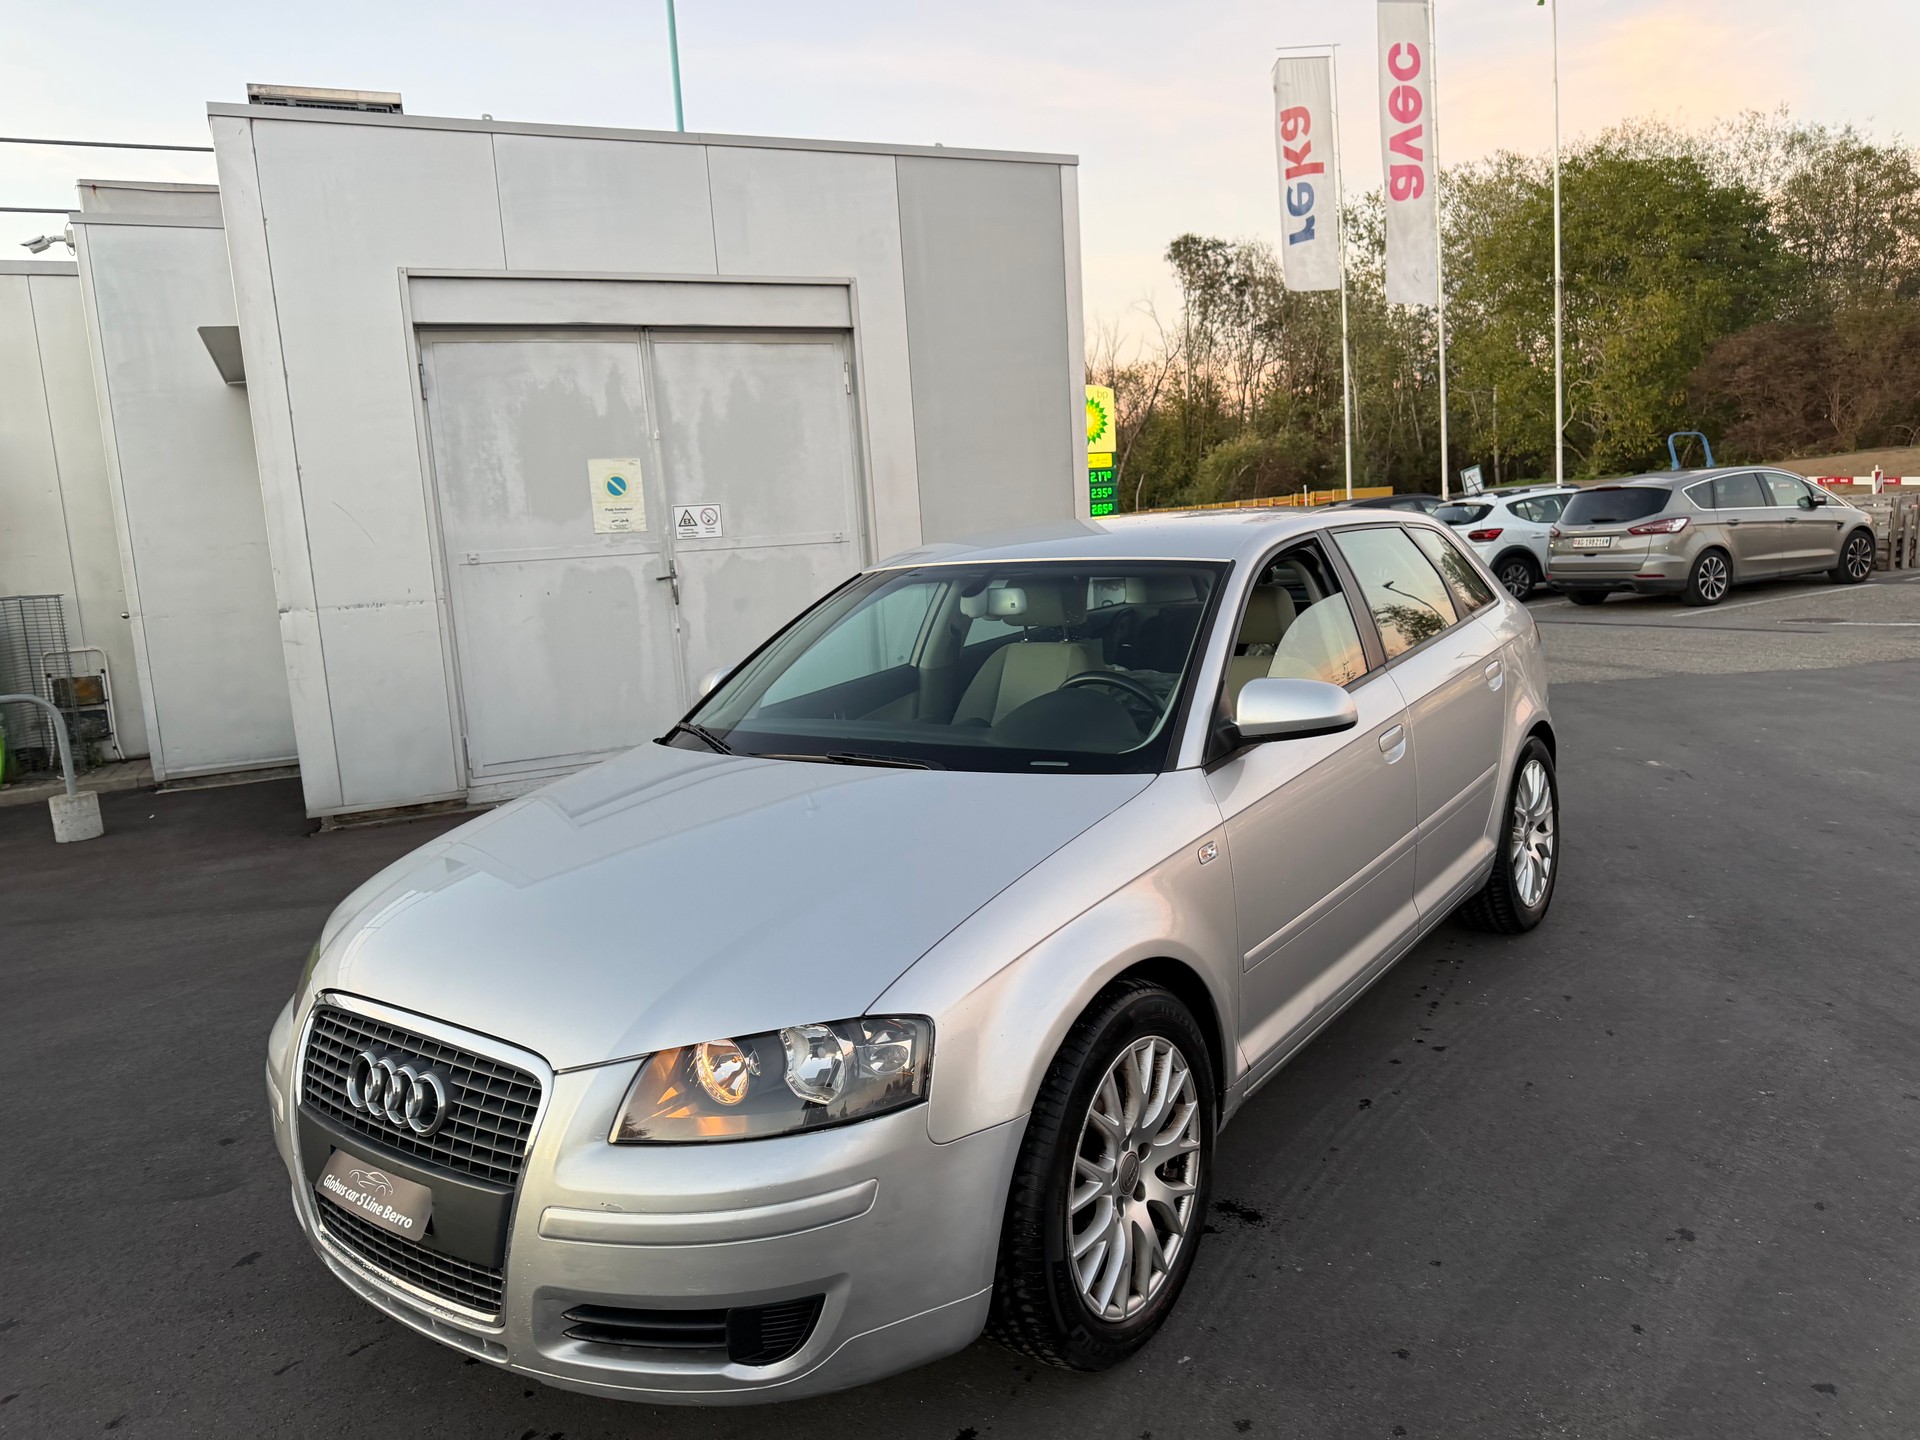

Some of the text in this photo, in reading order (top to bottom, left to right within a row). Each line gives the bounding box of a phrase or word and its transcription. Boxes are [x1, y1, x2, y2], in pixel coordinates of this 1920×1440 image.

[1096, 390, 1109, 399] bp
[323, 1174, 348, 1197] Globus
[345, 1188, 360, 1203] car
[363, 1195, 384, 1216] Line
[382, 1205, 413, 1229] Berro
